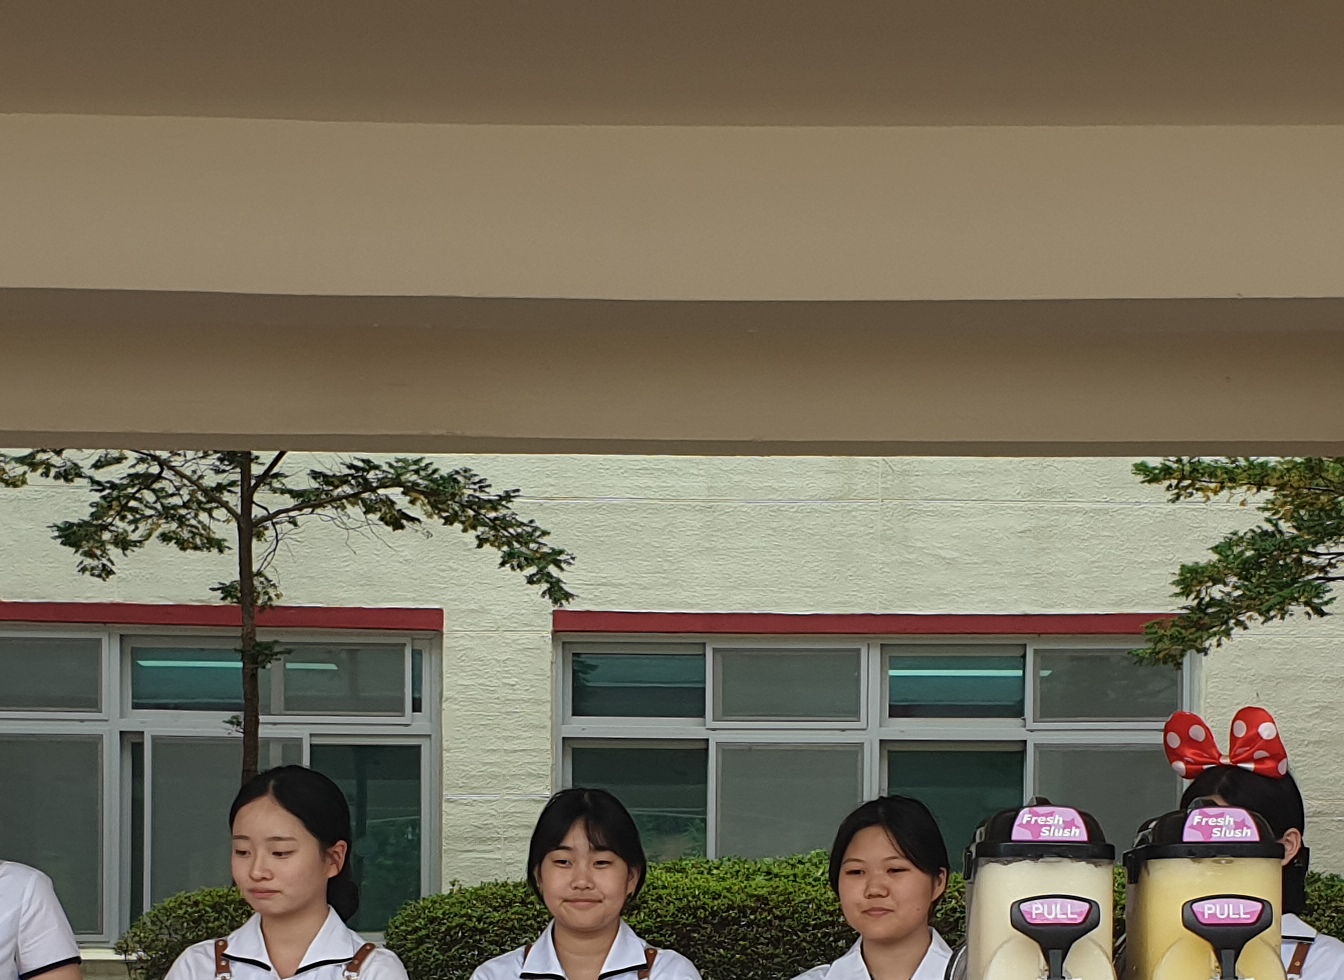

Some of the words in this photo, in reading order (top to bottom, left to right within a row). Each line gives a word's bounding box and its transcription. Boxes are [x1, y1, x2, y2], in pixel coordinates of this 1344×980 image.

[1021, 813, 1064, 826] Fresh
[1192, 814, 1235, 827] Fresh
[1040, 826, 1081, 837] Slush
[1211, 827, 1252, 838] Slush
[1030, 902, 1078, 919] PULL
[1203, 902, 1251, 919] PULL
